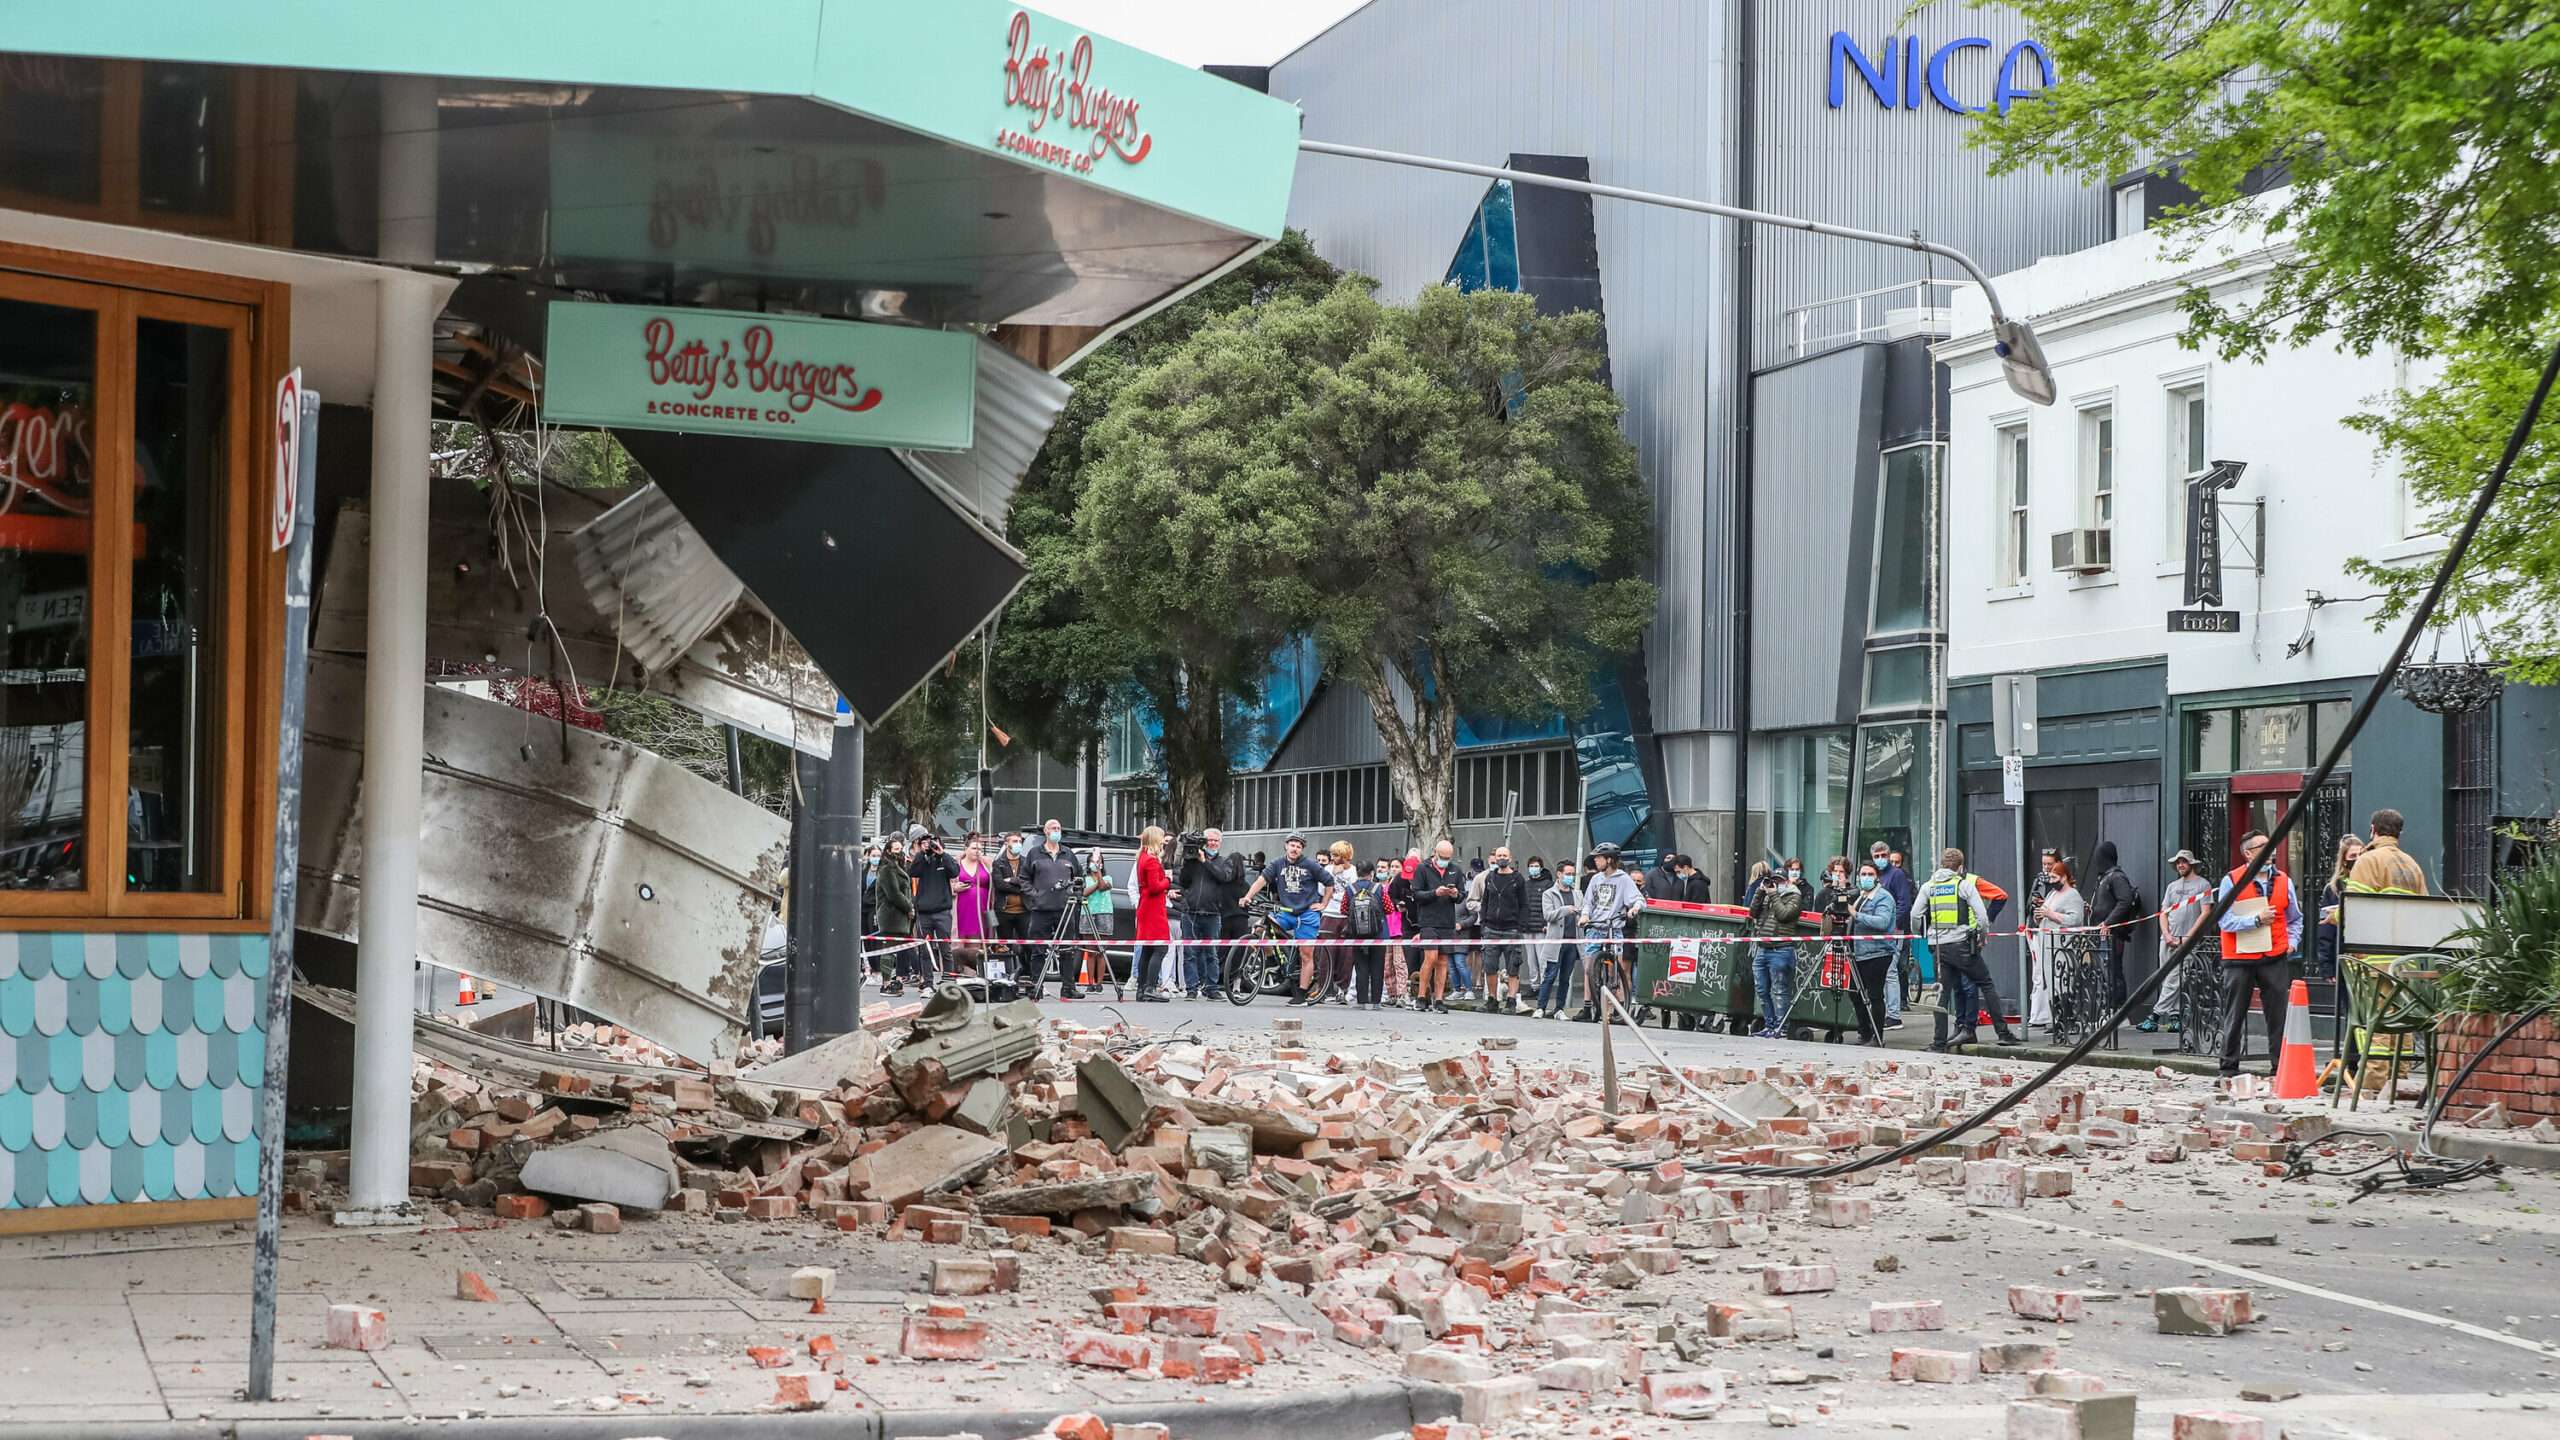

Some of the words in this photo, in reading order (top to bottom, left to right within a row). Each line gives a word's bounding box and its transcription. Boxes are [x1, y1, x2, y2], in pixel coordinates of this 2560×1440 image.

[1006, 12, 1065, 132] Betty's
[1070, 35, 1153, 163] Burgers
[1828, 31, 2057, 116] NICA
[1008, 131, 1071, 167] CONCRETE
[645, 319, 738, 400] Betty's
[744, 325, 883, 413] Burgers
[660, 402, 758, 421] CONCRETE
[765, 409, 796, 424] CO.
[2181, 612, 2230, 632] tusk
